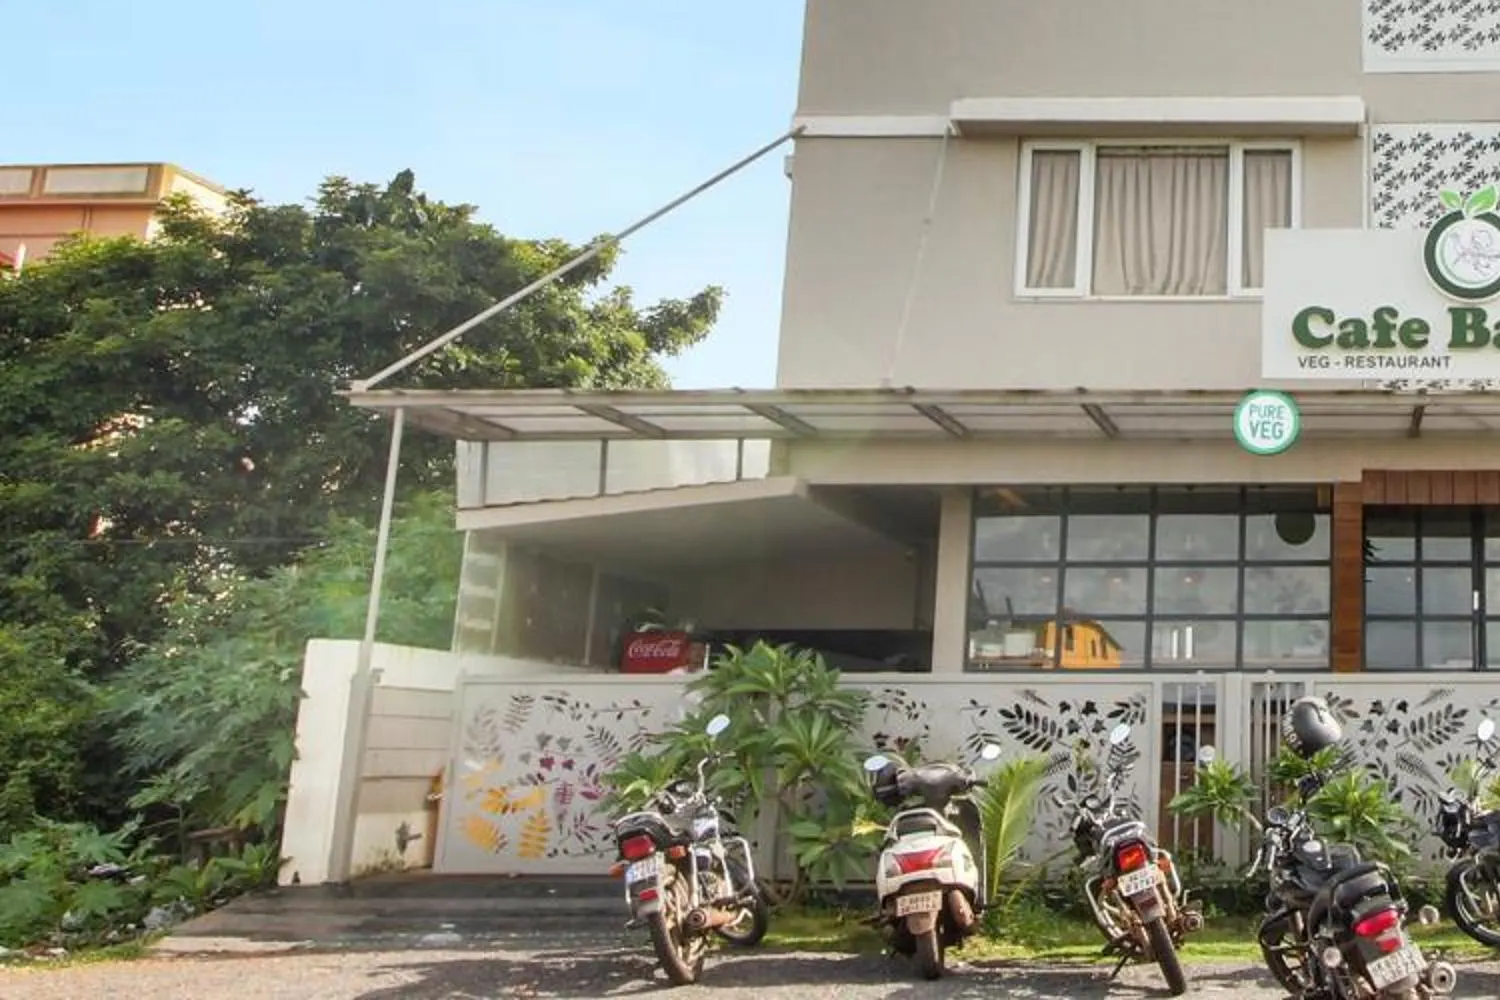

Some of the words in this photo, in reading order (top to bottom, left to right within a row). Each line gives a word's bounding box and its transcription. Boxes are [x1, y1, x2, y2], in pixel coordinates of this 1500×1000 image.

[1291, 305, 1430, 350] Cafe
[1297, 355, 1330, 369] VEG
[1344, 355, 1451, 369] RESTAURANT
[1249, 403, 1285, 420] PURE
[1249, 421, 1285, 440] VEG
